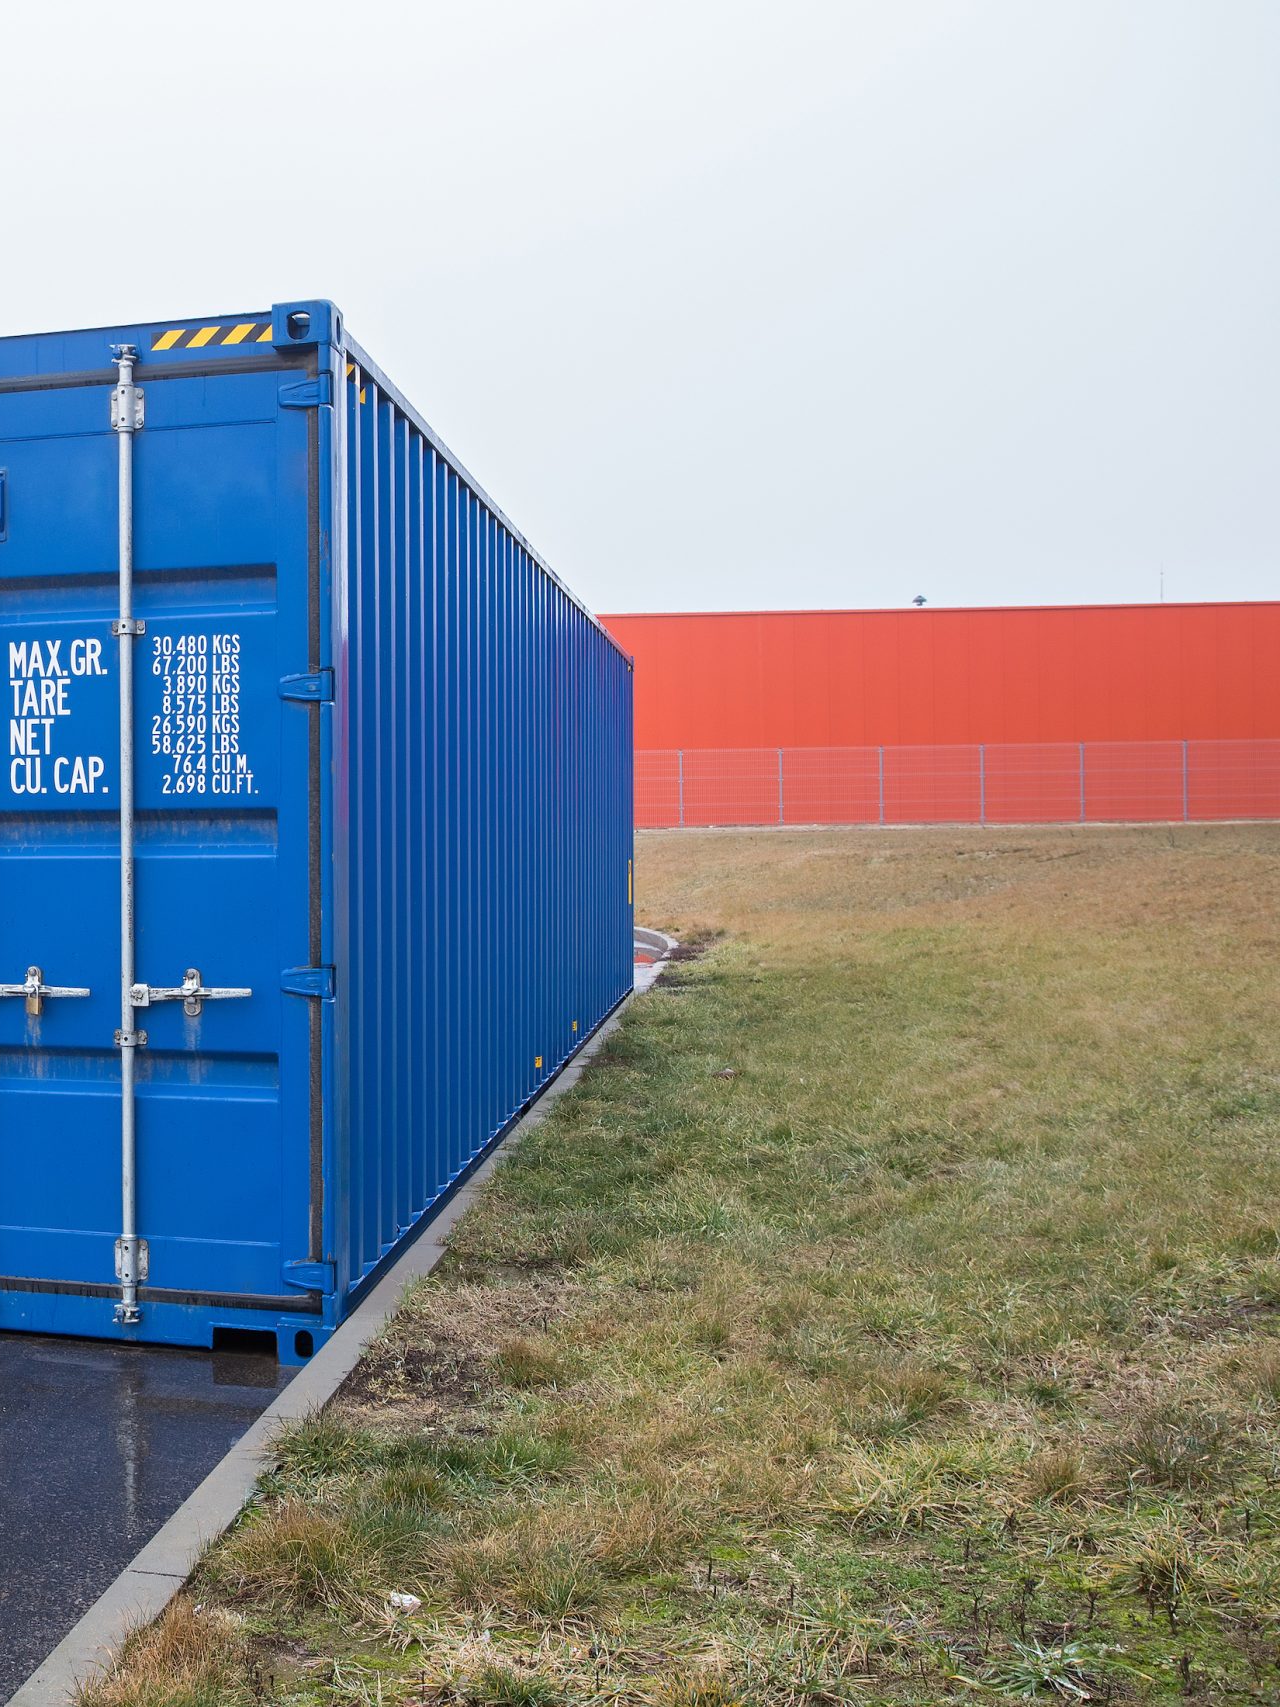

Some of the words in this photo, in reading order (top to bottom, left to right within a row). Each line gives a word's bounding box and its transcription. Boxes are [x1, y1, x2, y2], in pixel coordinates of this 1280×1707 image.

[152, 635, 208, 656] 30,480
[212, 634, 241, 655] KGS
[152, 655, 208, 675] 67,200
[212, 654, 240, 674] LBS
[162, 674, 207, 695] 3,890
[212, 674, 240, 694] KGS
[9, 678, 71, 717] TARE
[162, 694, 207, 715] 8,575
[212, 693, 240, 714] LBS
[151, 714, 207, 735] 26,590
[212, 713, 240, 734] KGS
[10, 718, 55, 756] NET
[151, 734, 207, 755] 58,625
[211, 733, 240, 754] LBS
[172, 754, 207, 774] 76.4
[211, 753, 252, 774] CU.M.
[10, 757, 48, 794] CU.
[53, 756, 109, 794] CAP.
[162, 774, 206, 794] 2,698
[211, 773, 259, 794] CU.FT.
